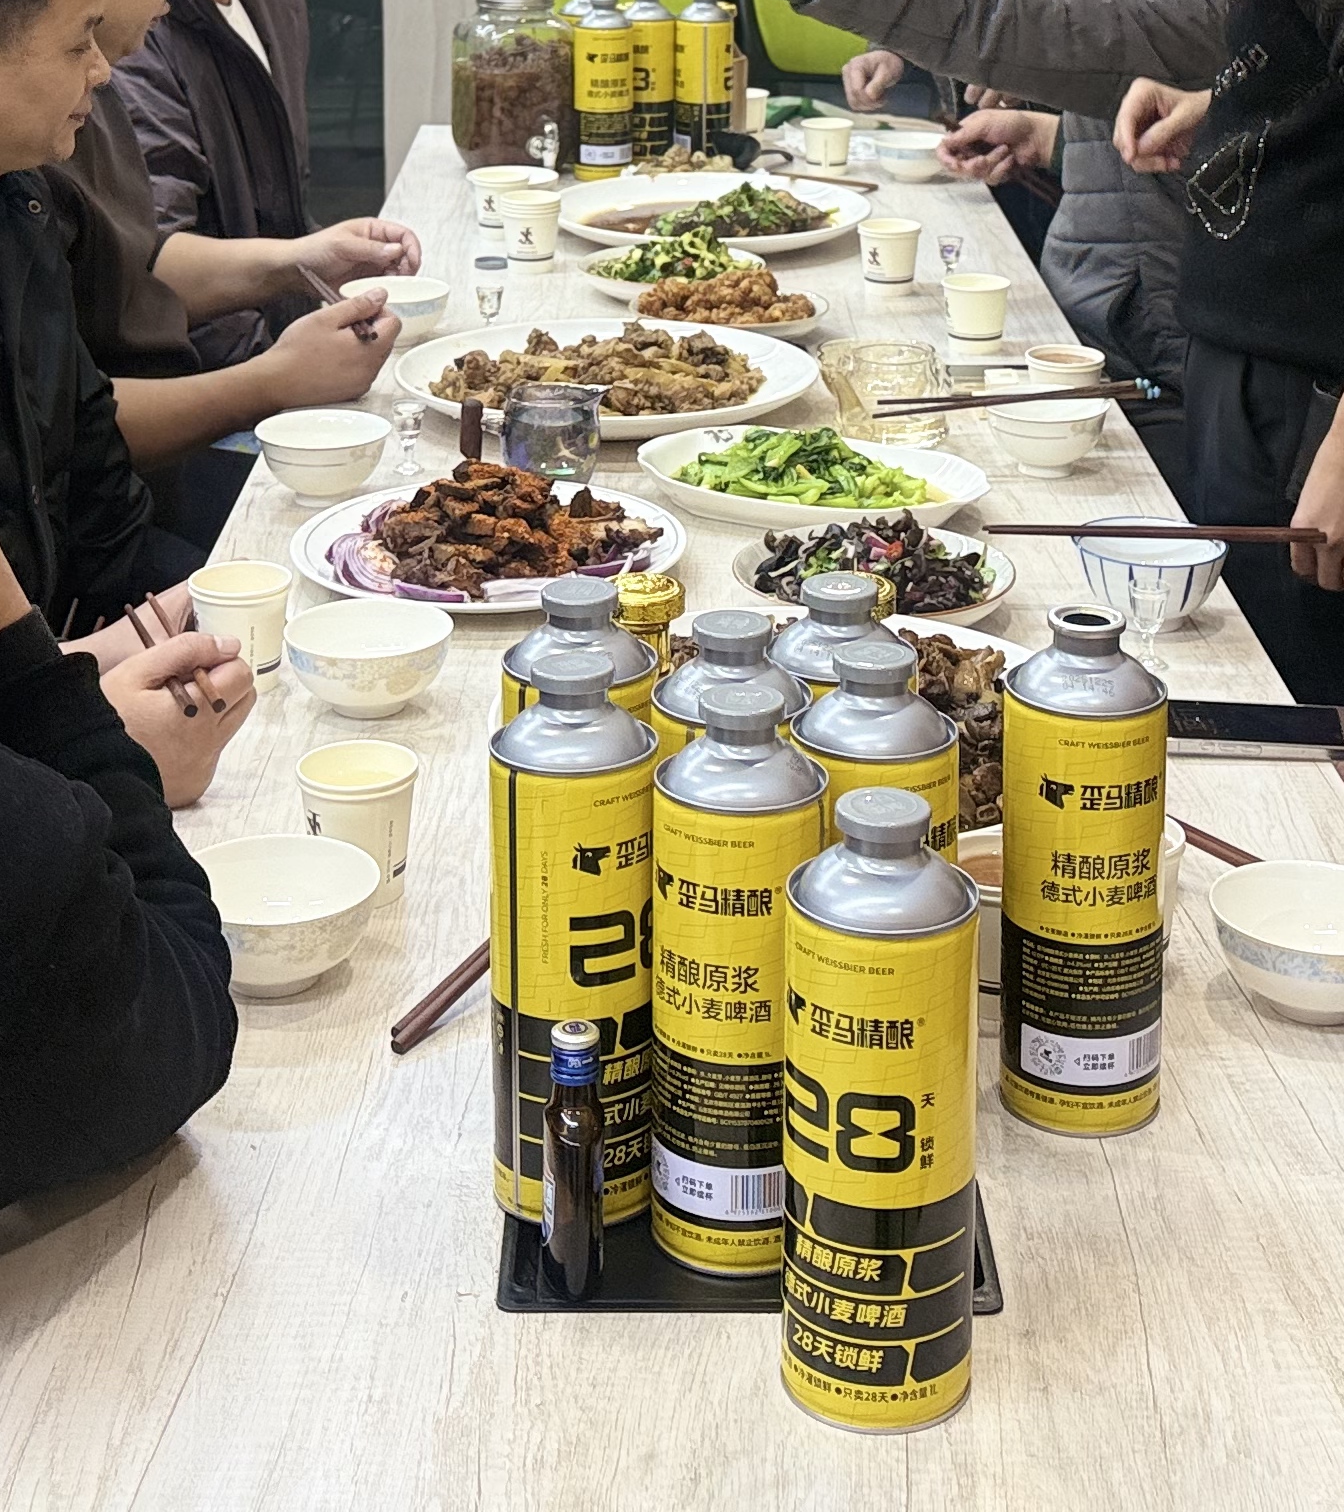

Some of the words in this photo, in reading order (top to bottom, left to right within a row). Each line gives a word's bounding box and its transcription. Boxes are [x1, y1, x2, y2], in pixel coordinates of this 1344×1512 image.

[1058, 737, 1086, 749] CRAFT
[1087, 738, 1131, 750] WEISSBIER
[593, 796, 621, 807] CRAFT
[1079, 774, 1158, 812] 歪马精酿
[663, 823, 683, 839] CRAFT
[683, 832, 729, 849] WEISSBIER
[730, 840, 755, 849] BEER
[540, 851, 549, 874] DAYS
[1050, 847, 1152, 882] 精酿原浆
[540, 876, 549, 888] 28
[678, 877, 773, 918] 歪马精酿
[1040, 873, 1158, 908] 德式小麦啤酒
[540, 888, 549, 914] ONLY
[540, 914, 549, 933] FOR
[540, 934, 549, 964] FRESH
[794, 941, 816, 961] CRAFT
[816, 952, 866, 975] WEISSBIER
[868, 966, 895, 977] BEER
[659, 944, 760, 994] 精酿原浆
[656, 974, 772, 1024] 德式小麦啤酒
[810, 1001, 915, 1051] 歪马精酿
[785, 1054, 916, 1174] 28
[920, 1091, 935, 1109] 天
[920, 1135, 935, 1170] 锁鲜
[795, 1233, 884, 1283] 精酿原浆
[792, 1323, 885, 1374] 28天锁鲜
[842, 1387, 889, 1403] 只卖28天
